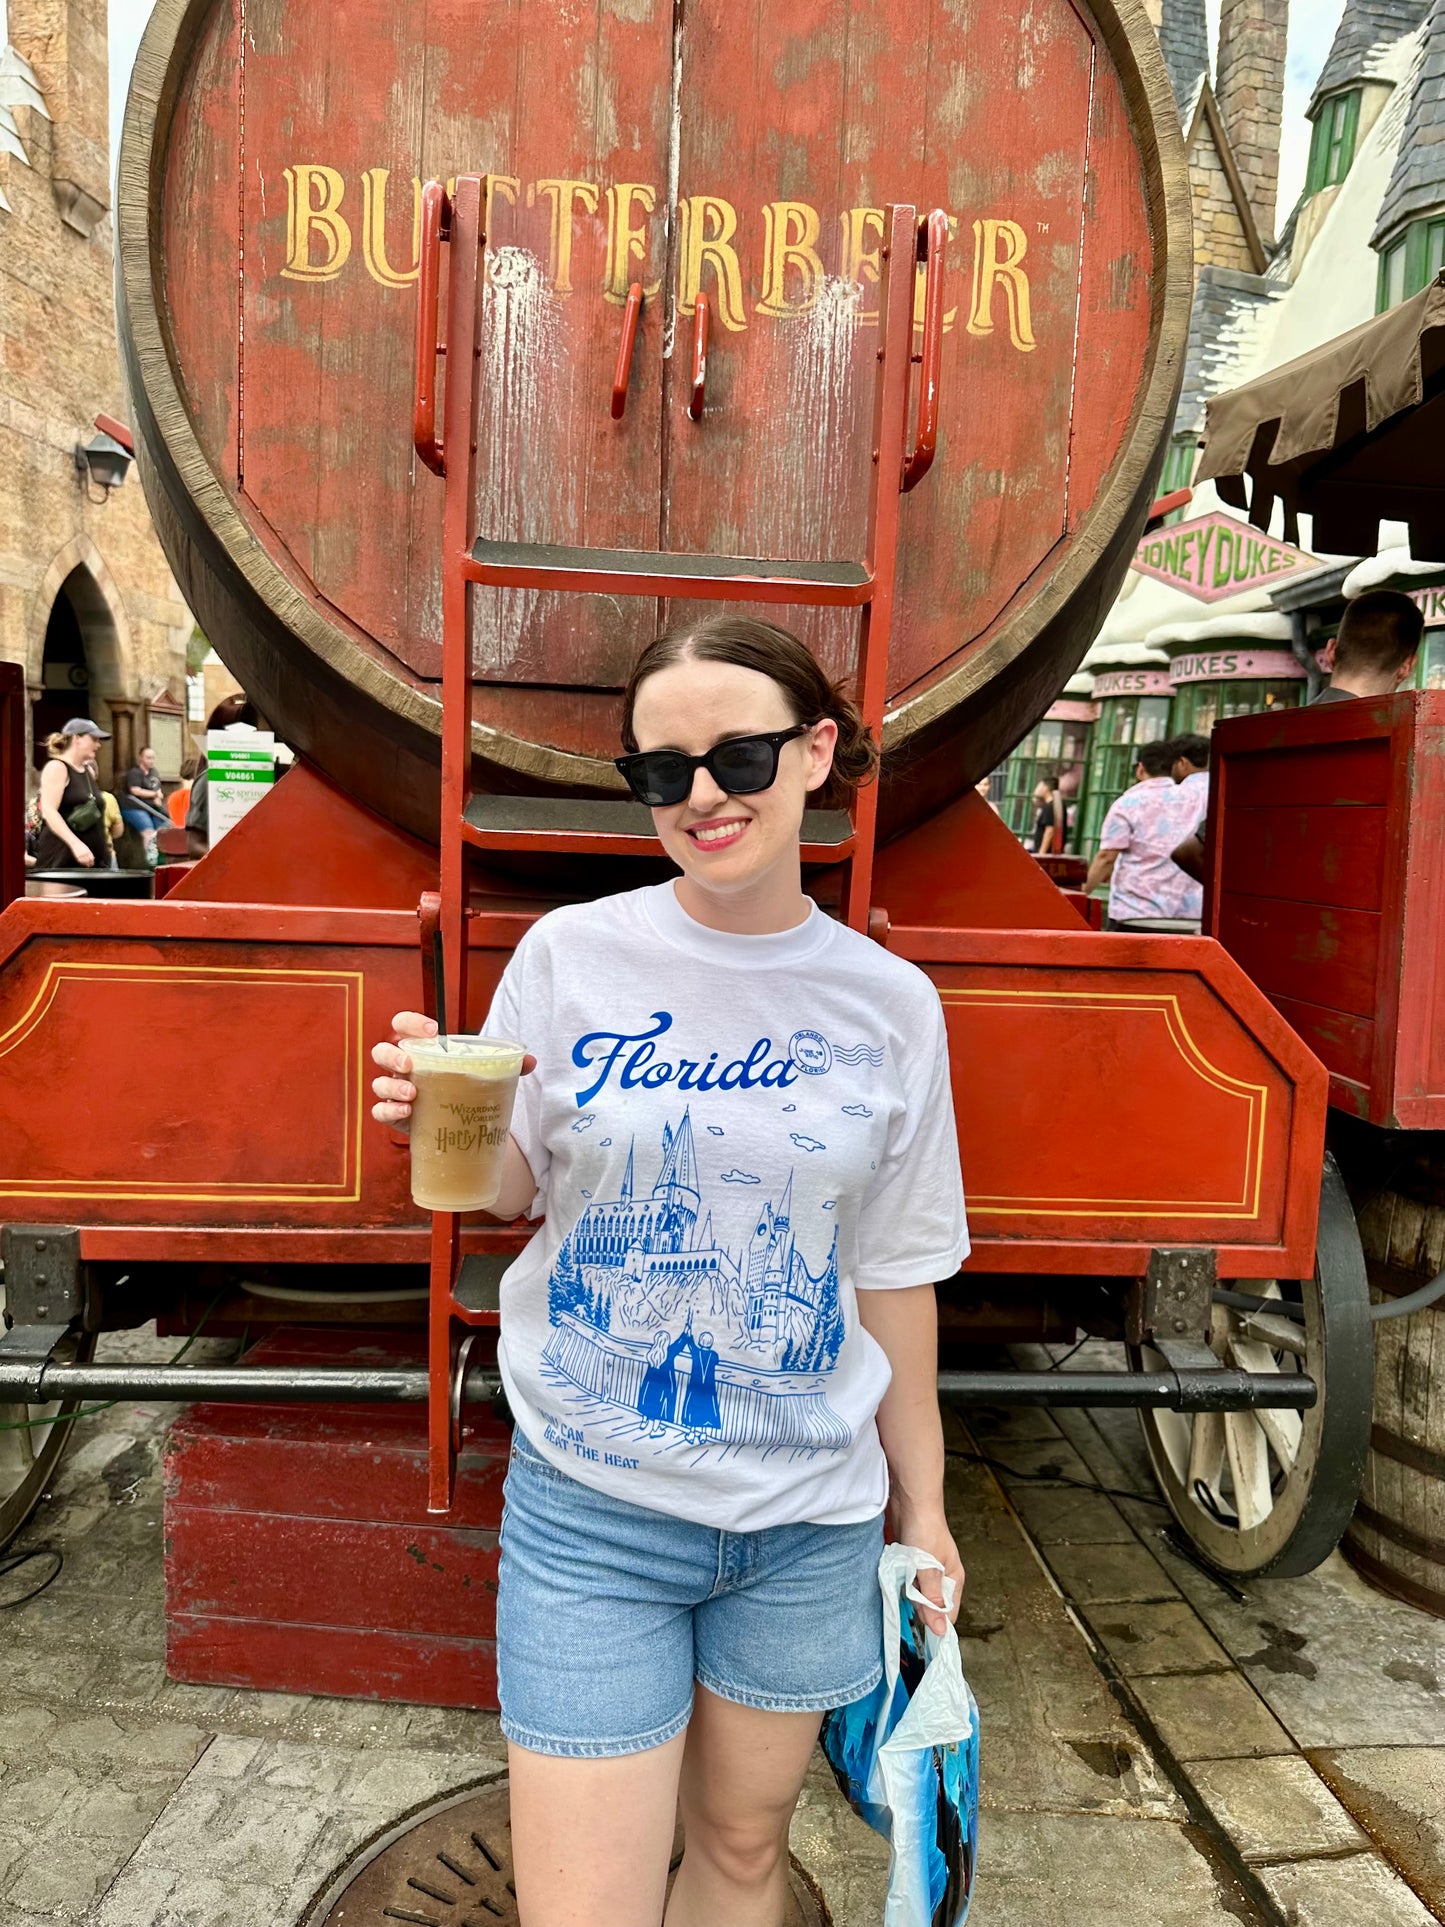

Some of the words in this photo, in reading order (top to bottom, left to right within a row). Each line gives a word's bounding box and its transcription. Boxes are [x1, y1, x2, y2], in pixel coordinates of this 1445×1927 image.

[571, 1011, 799, 1109] Florida
[435, 1127, 477, 1153] Harry
[543, 1424, 569, 1451] BEAT
[573, 1443, 600, 1462] THE
[604, 1452, 640, 1470] HEAT
[560, 1423, 584, 1443] CAN
